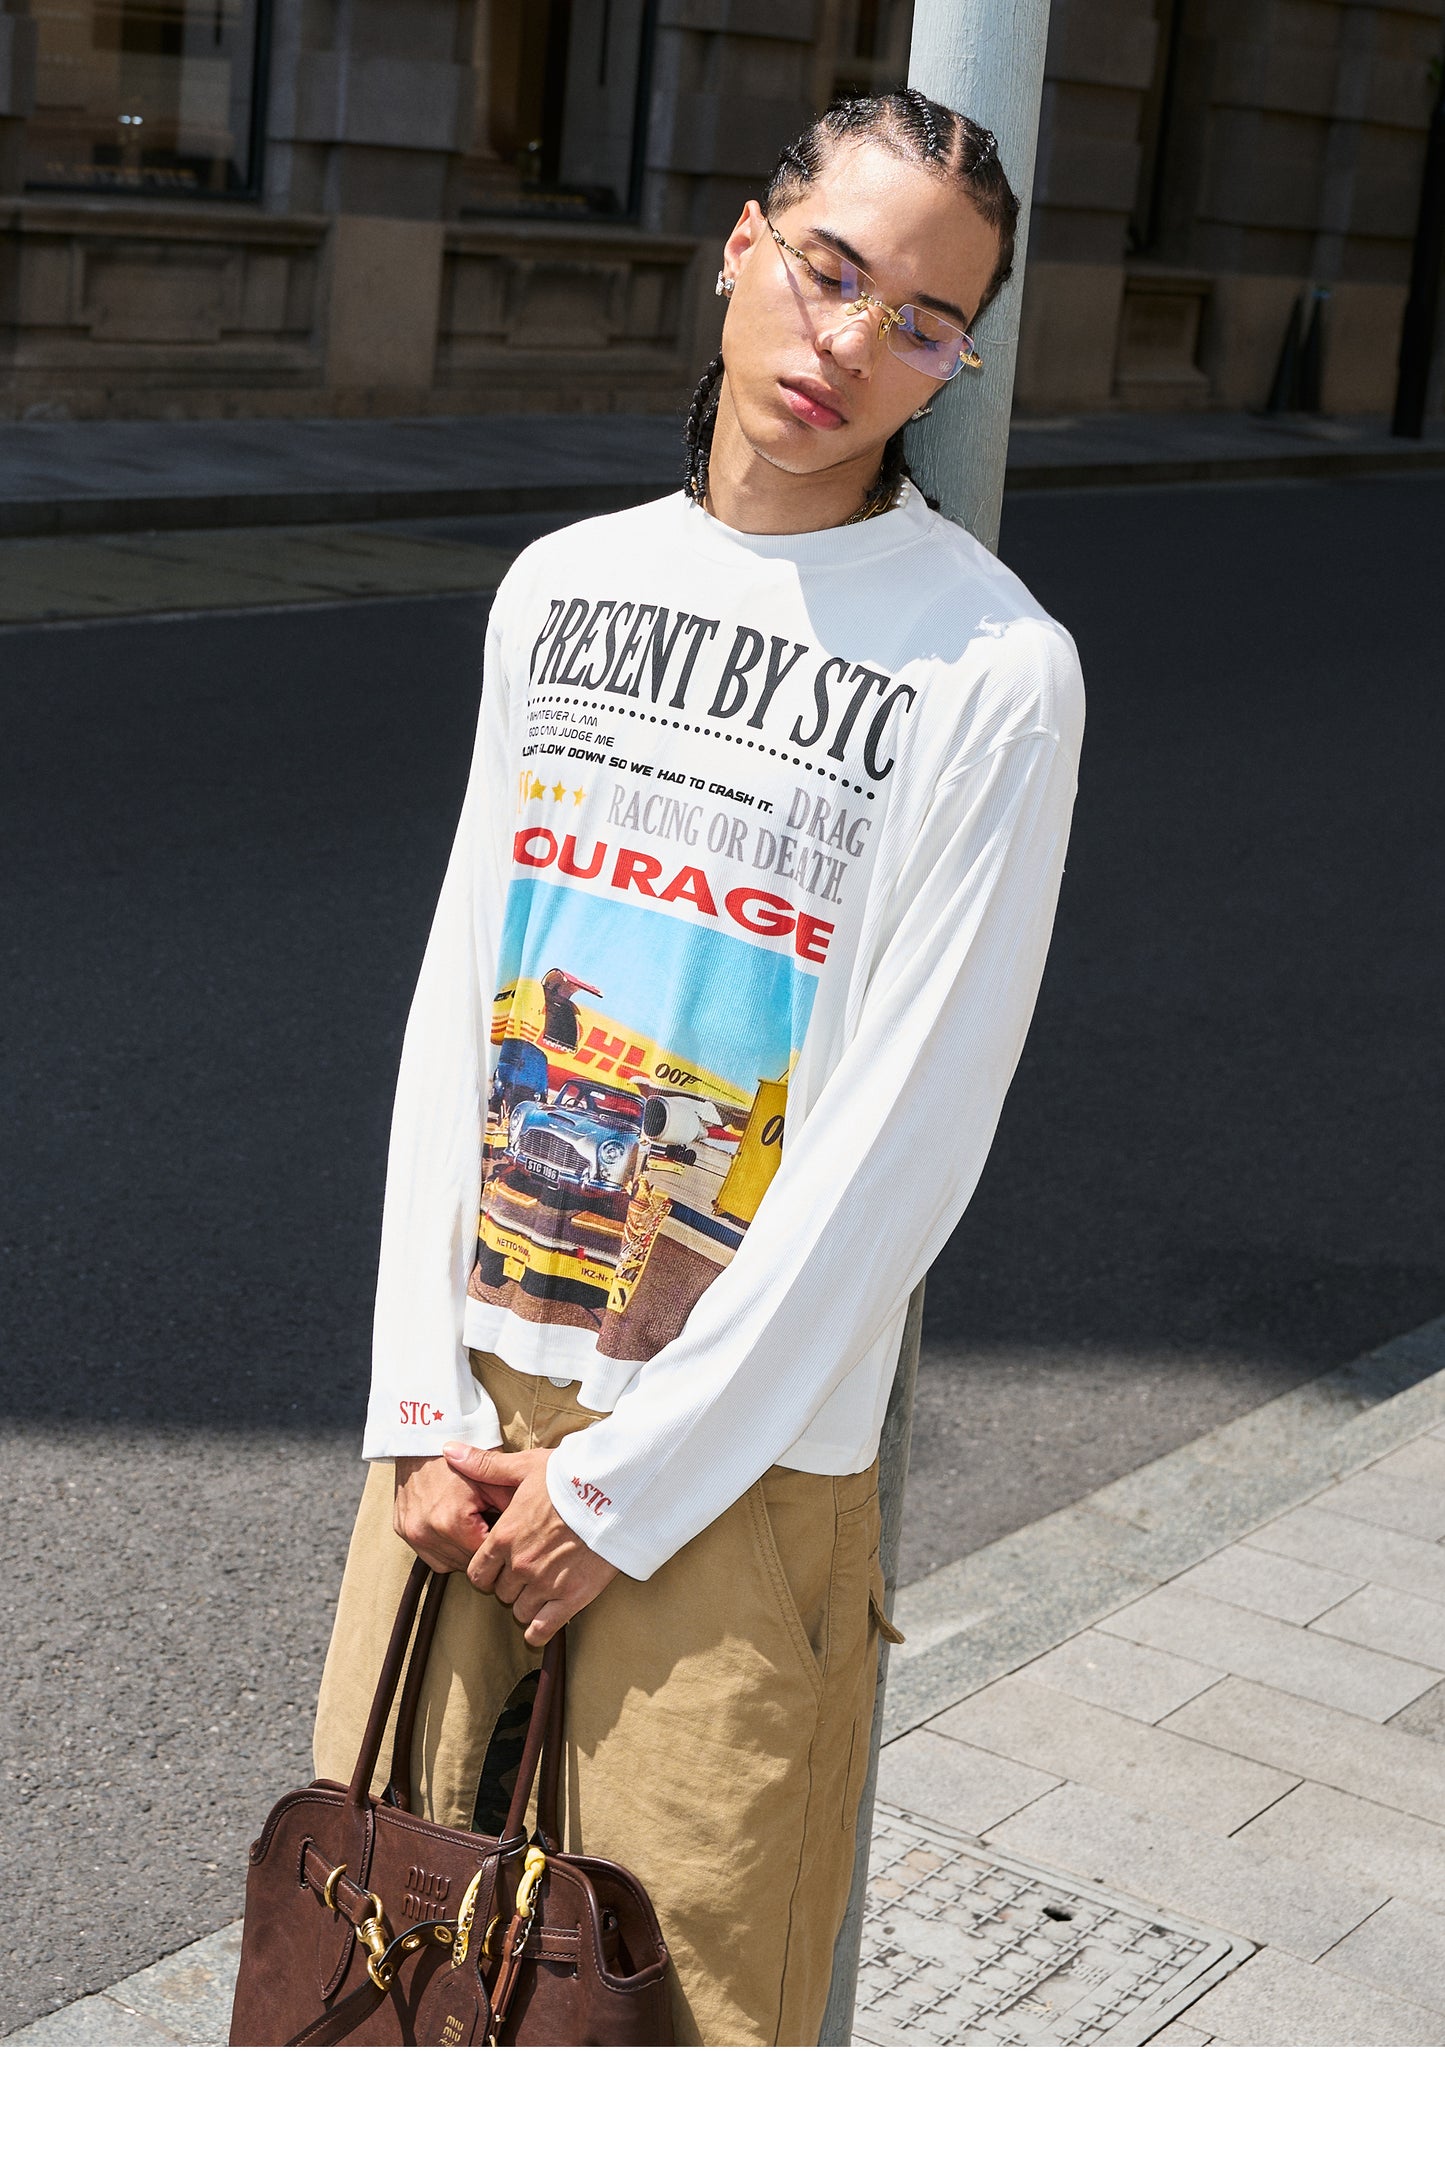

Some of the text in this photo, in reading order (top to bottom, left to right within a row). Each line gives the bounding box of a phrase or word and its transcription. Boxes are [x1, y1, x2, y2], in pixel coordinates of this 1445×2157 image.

[529, 598, 917, 781] PRESENT BY STC
[578, 714, 598, 727] AM
[558, 727, 593, 743] JUDGE
[594, 734, 615, 748] ME
[567, 747, 606, 764] DOWN
[608, 756, 628, 770] SO
[630, 762, 654, 777] WE
[657, 769, 686, 785] HAD
[689, 777, 706, 790] TO
[708, 783, 755, 806] CRASH
[757, 799, 774, 814] IT.
[786, 787, 872, 858] DRAG
[606, 784, 704, 847] RACING
[706, 812, 749, 862] OR
[751, 827, 848, 905] DEATH.
[512, 827, 835, 965] OURAGE
[655, 1063, 702, 1088] 007
[527, 1160, 542, 1174] STC
[496, 1236, 518, 1251] NETTO
[400, 1400, 431, 1426] STC
[577, 1483, 612, 1516] STC
